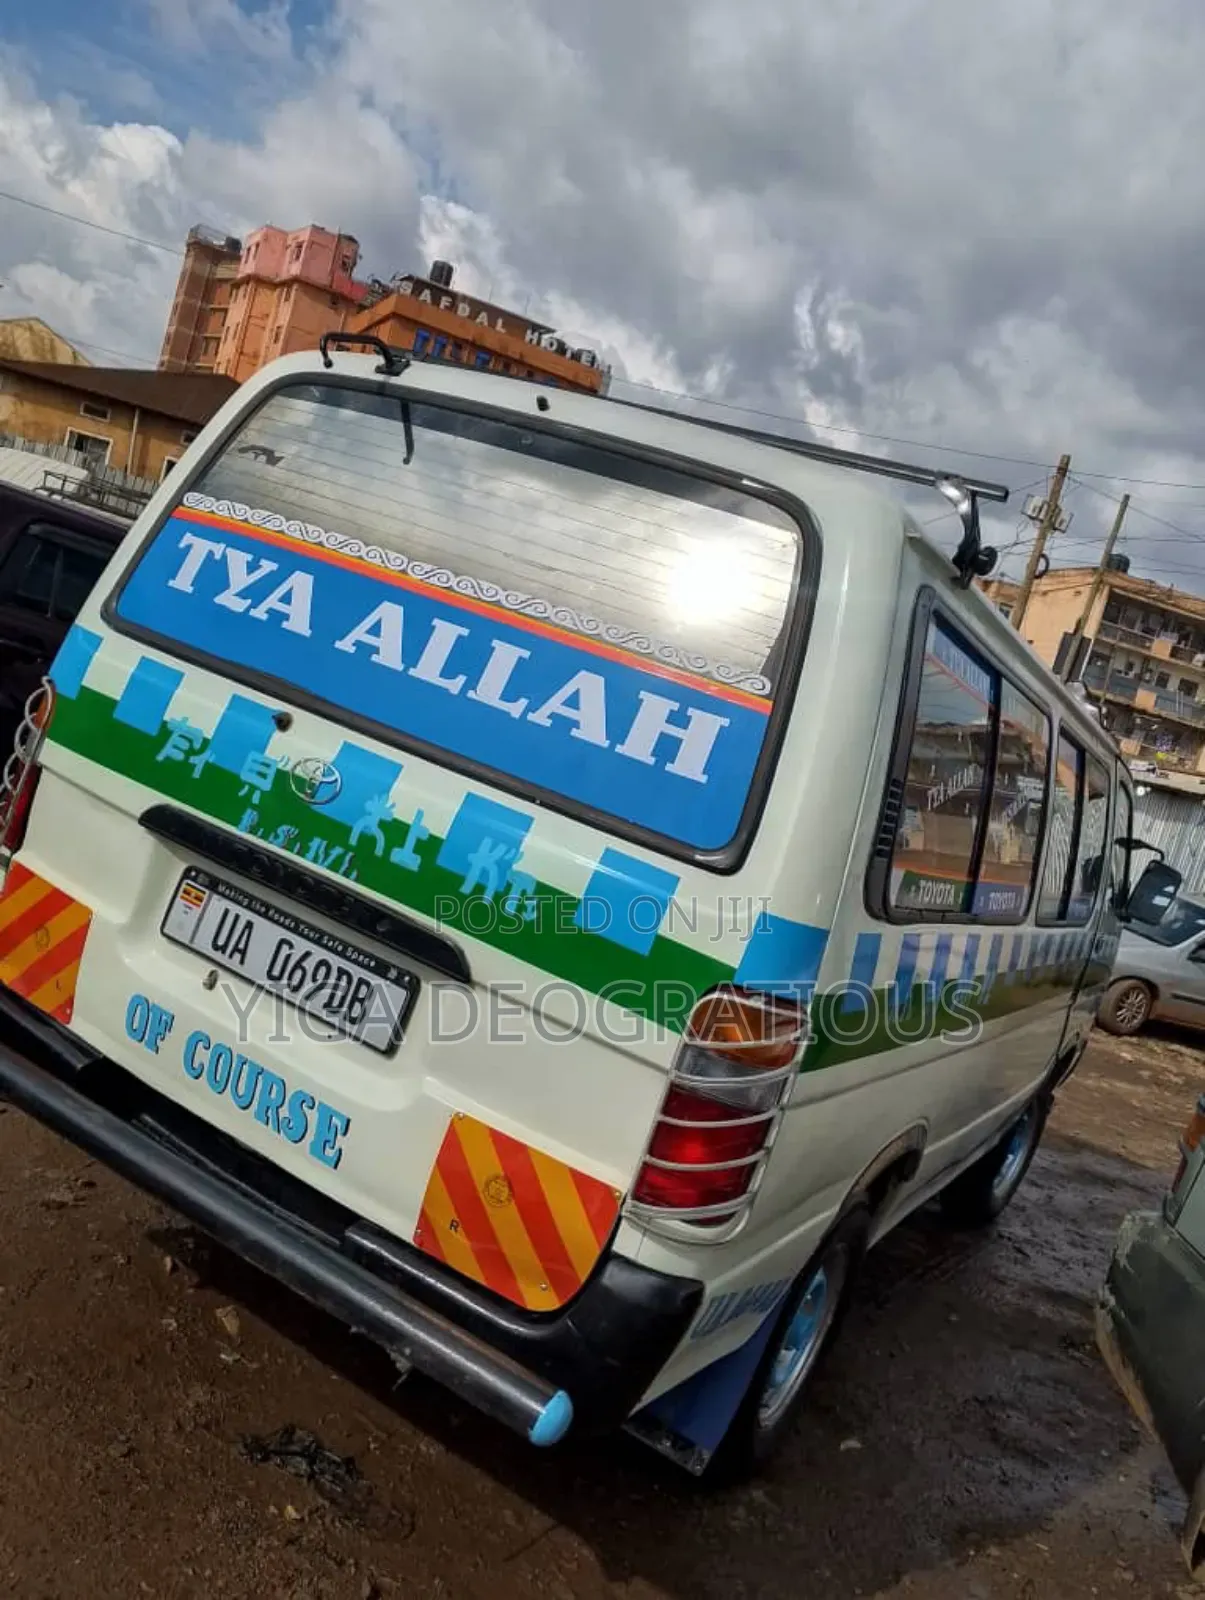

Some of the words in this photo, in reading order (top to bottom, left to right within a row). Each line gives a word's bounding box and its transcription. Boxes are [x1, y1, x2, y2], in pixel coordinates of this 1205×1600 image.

[167, 531, 315, 637] TYA
[334, 601, 730, 784] ALLAH
[918, 879, 955, 905] TOYOTA
[211, 907, 254, 966] UA
[251, 900, 266, 913] the
[322, 935, 343, 952] Safe
[347, 946, 376, 967] Space
[125, 993, 175, 1055] OF
[183, 1030, 352, 1170] COURSE
[448, 1218, 461, 1234] R
